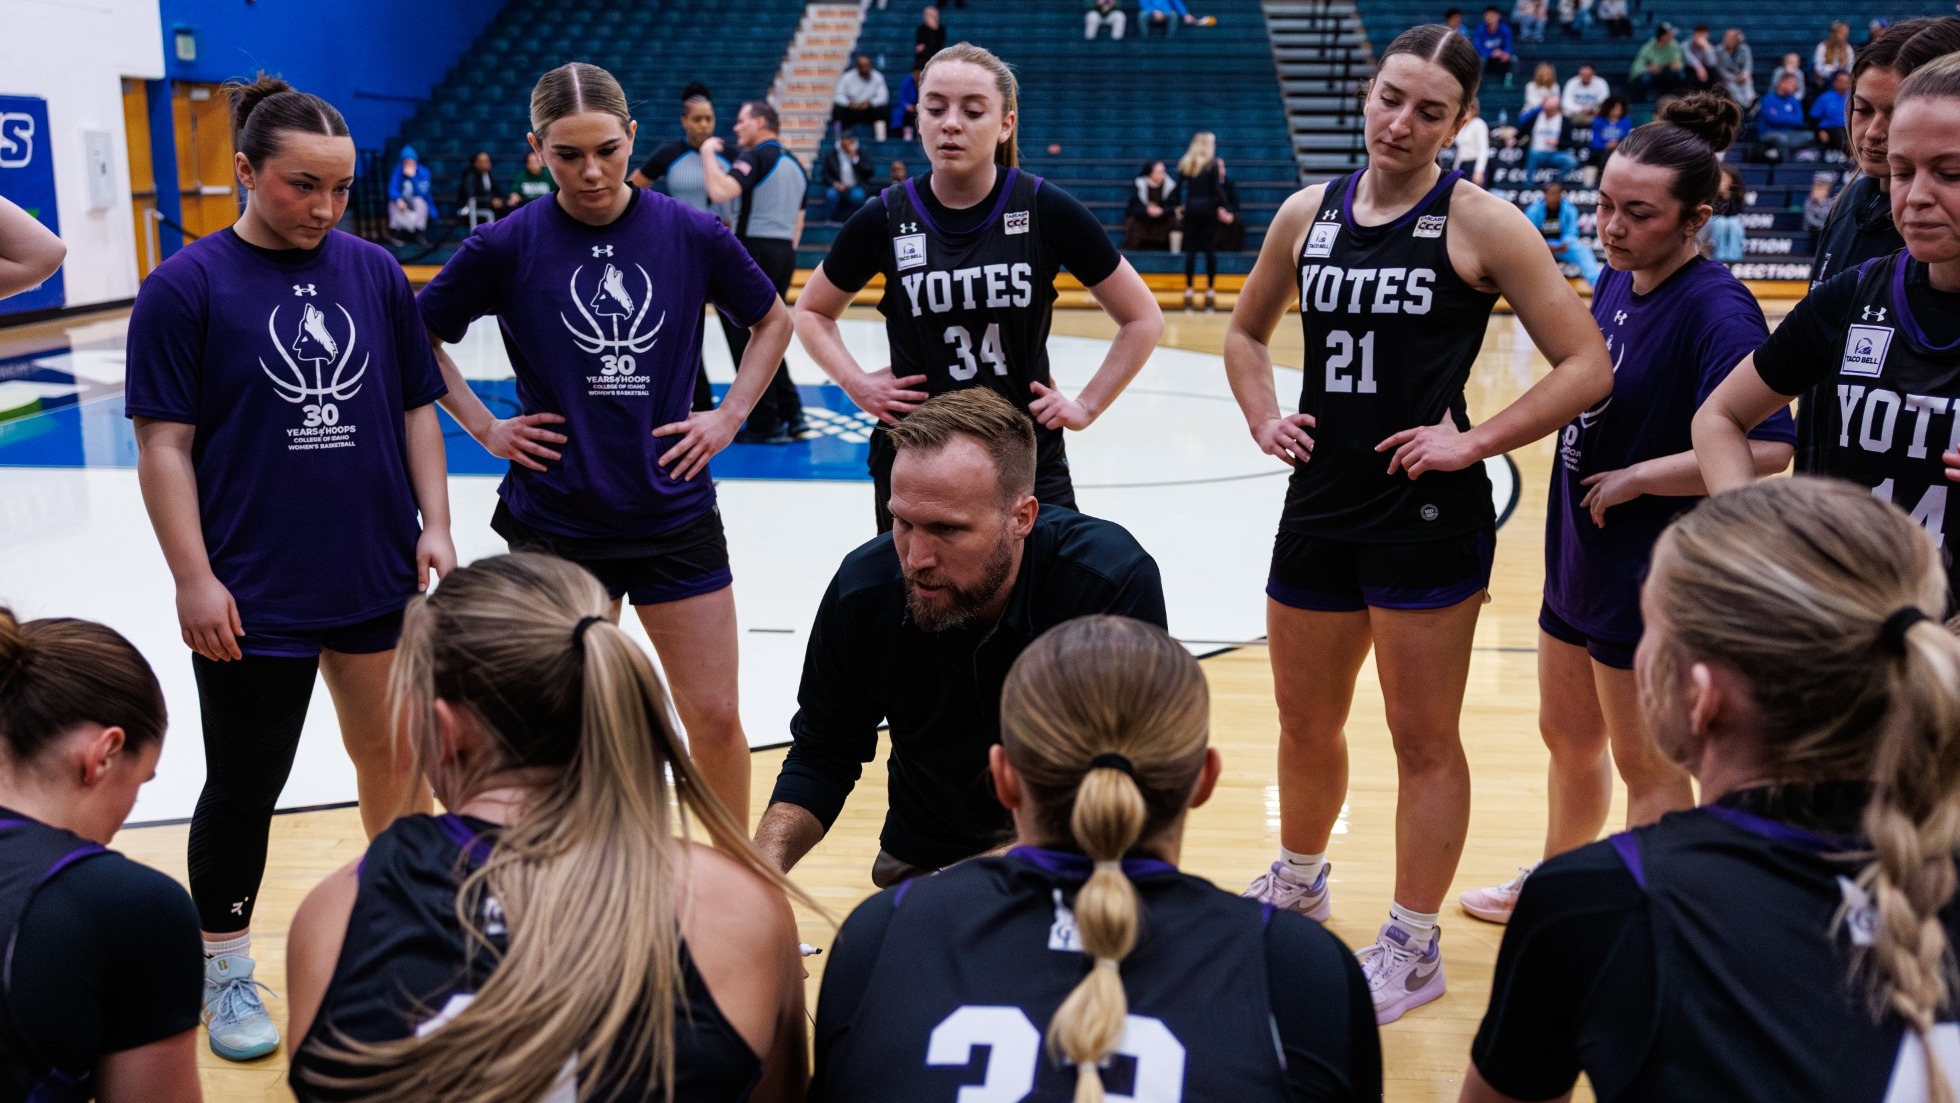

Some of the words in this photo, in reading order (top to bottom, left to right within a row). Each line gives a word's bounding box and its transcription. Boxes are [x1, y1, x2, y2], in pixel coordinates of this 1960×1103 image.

[1006, 217, 1028, 228] CCC
[1417, 221, 1443, 231] CCC
[901, 262, 1032, 318] YOTES
[1301, 264, 1437, 316] YOTES
[943, 323, 1008, 381] 34
[1325, 329, 1377, 394] 21
[1846, 355, 1861, 363] TACO
[1860, 356, 1879, 365] BELL
[600, 354, 636, 376] 30
[302, 403, 339, 427] 30
[286, 428, 318, 436] YEARS
[325, 425, 356, 434] HOOPS
[320, 441, 356, 449] BASKETBALL
